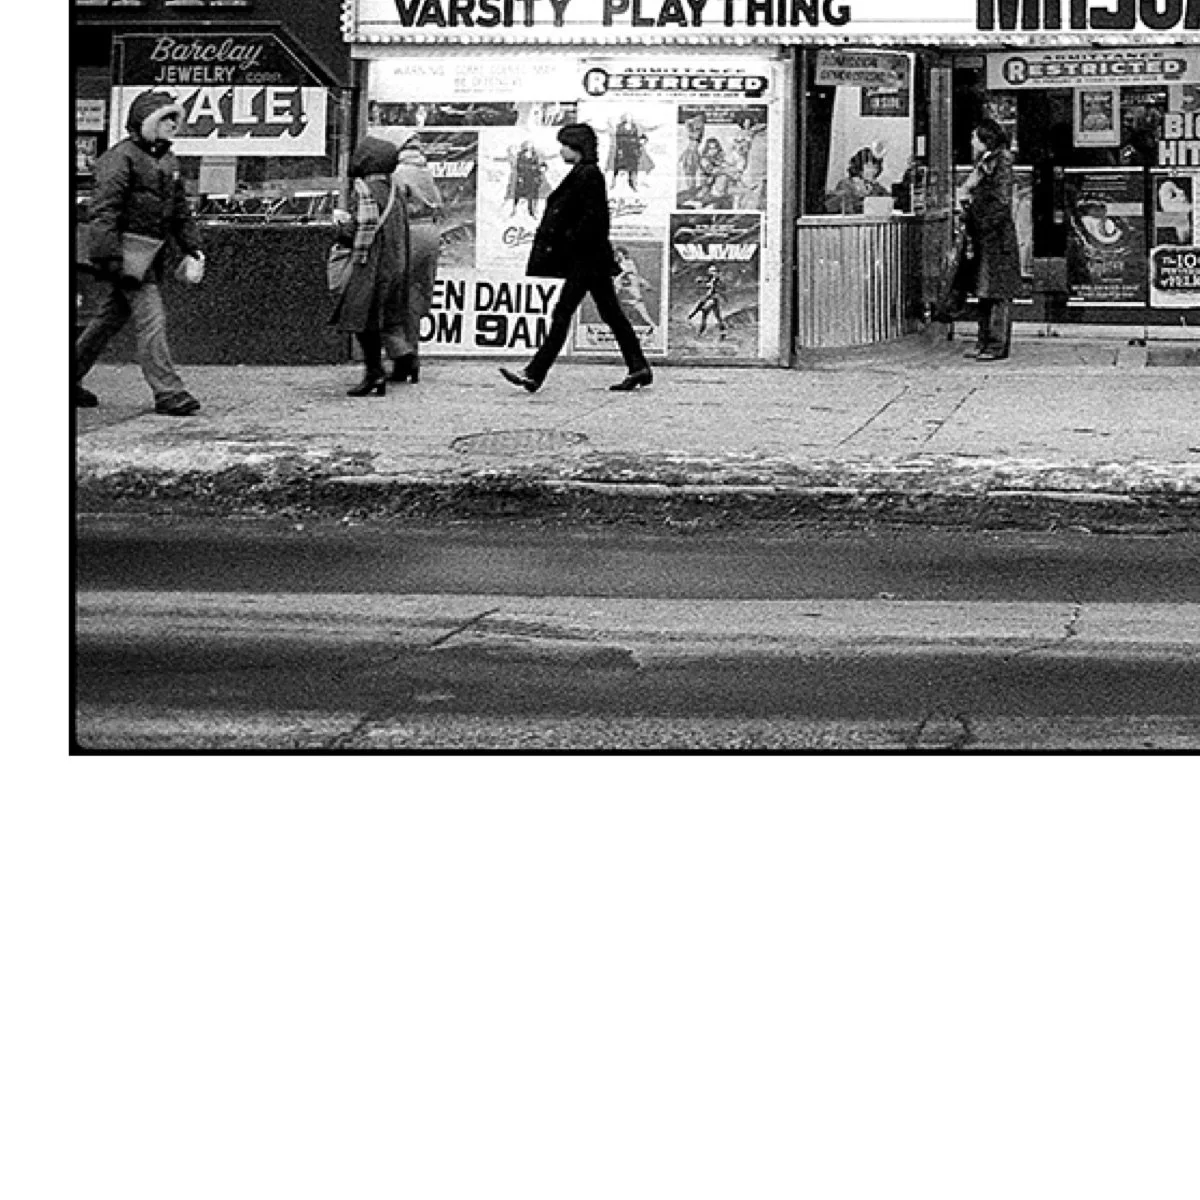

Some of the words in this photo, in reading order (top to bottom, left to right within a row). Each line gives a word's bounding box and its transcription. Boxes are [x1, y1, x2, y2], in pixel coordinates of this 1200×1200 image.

[150, 37, 264, 69] Barclay
[154, 65, 235, 82] JEWELRY
[583, 67, 769, 97] RESTRICTED
[1003, 56, 1188, 86] RESTRICTED
[176, 87, 311, 128] ALE!
[474, 282, 557, 314] DAILY
[475, 314, 508, 348] 9
